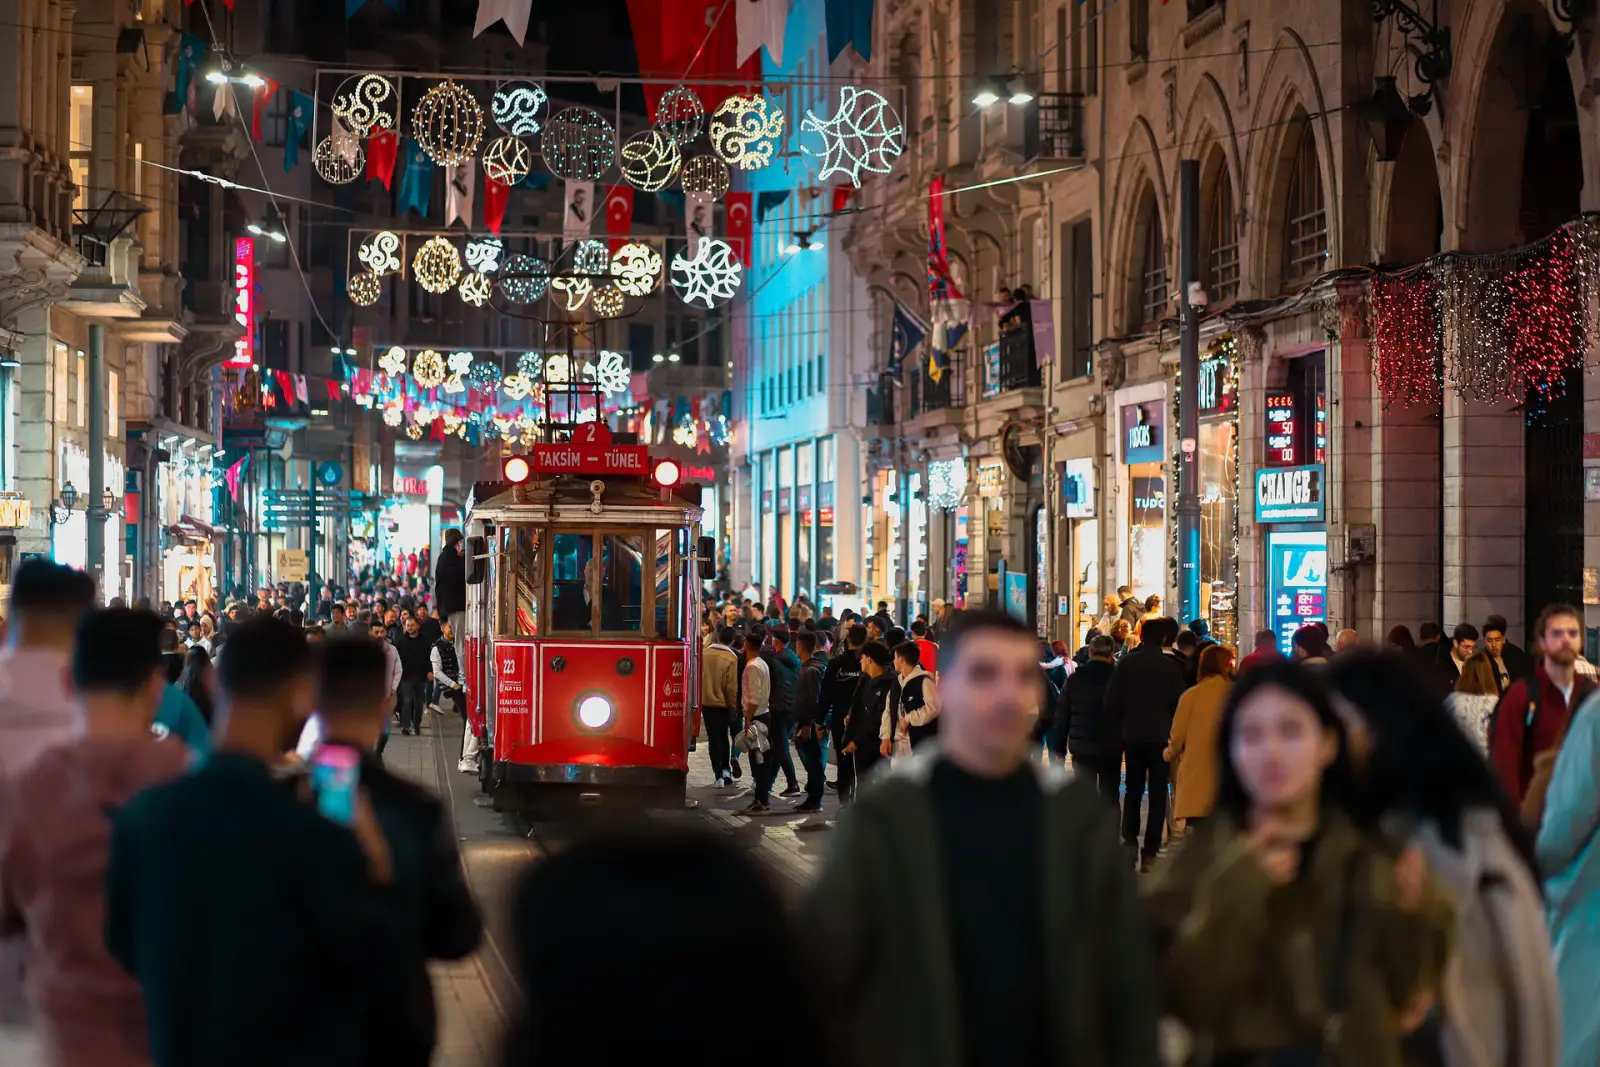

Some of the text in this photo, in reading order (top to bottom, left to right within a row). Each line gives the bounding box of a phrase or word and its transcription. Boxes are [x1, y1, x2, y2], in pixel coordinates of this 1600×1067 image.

[586, 423, 596, 442] 2
[538, 447, 581, 467] TAKSİM
[604, 448, 642, 468] TÜNEL
[1258, 470, 1311, 506] CHANGE
[503, 659, 515, 674] 223
